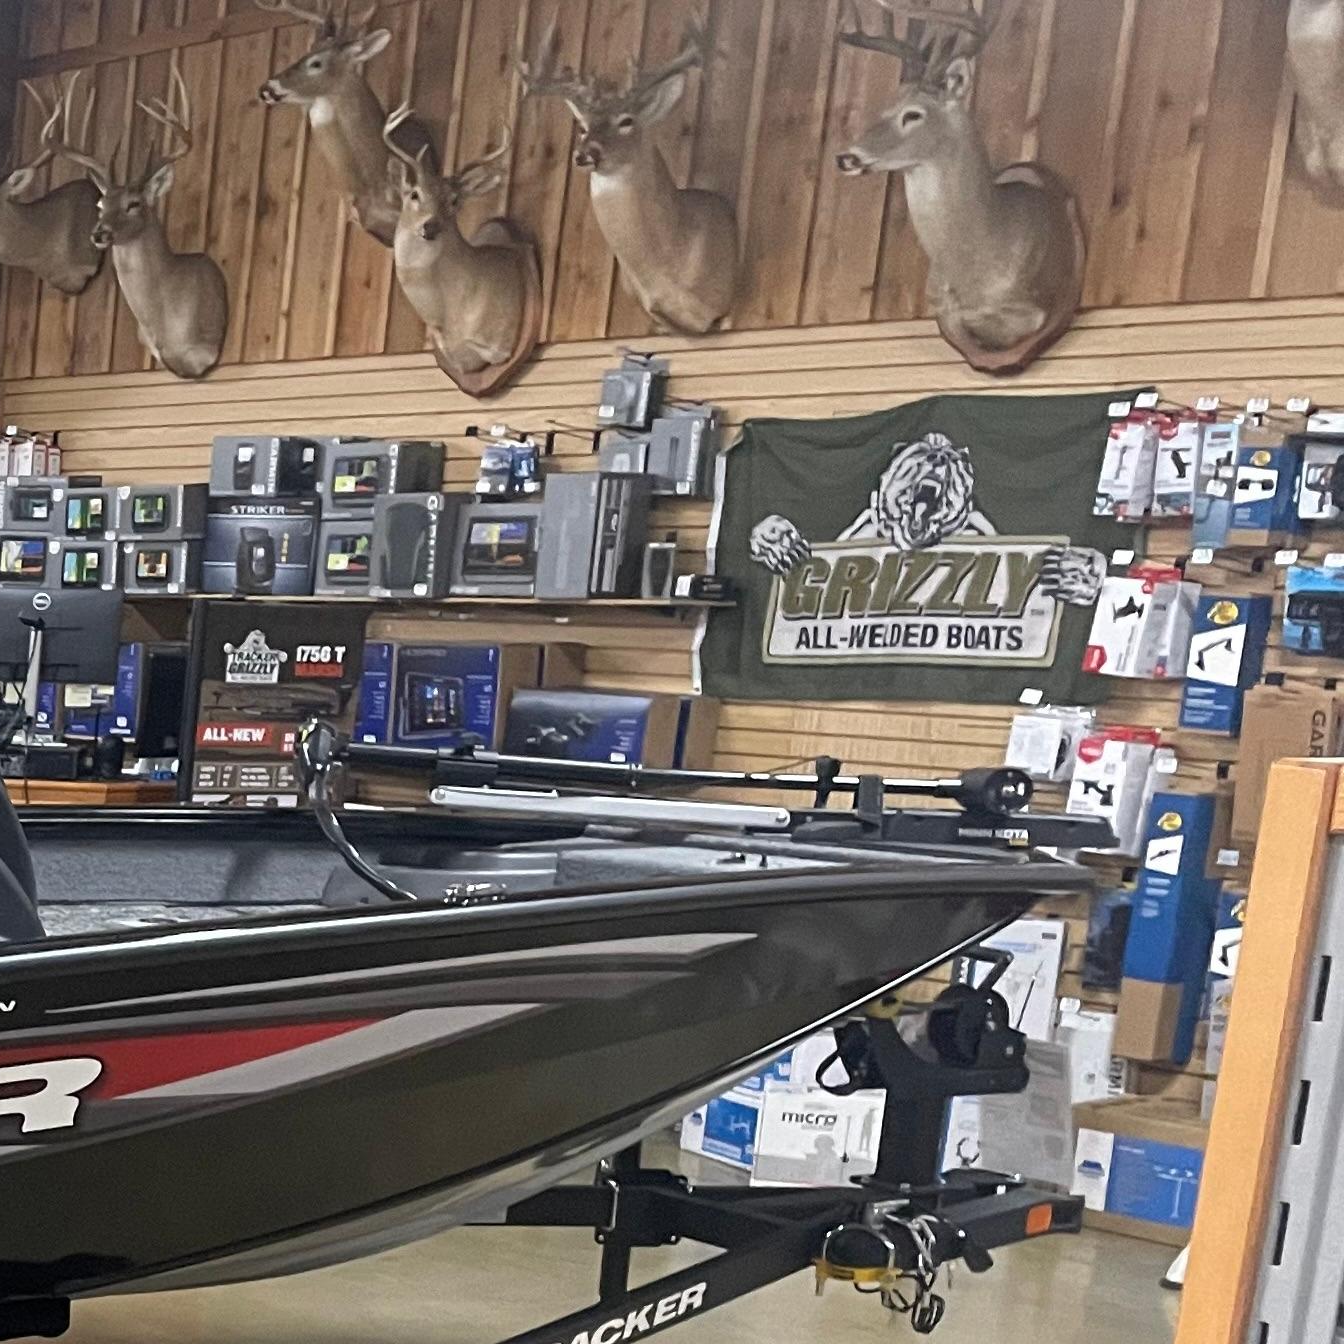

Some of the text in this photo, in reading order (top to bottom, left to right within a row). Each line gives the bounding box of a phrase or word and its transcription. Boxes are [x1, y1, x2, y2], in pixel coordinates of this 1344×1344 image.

[230, 504, 286, 515] STRIKER
[780, 550, 1047, 621] GRIZZLY
[795, 623, 1023, 651] ALL-WELDED BOATS
[334, 645, 347, 663] T
[228, 662, 278, 675] GRIZZLY
[202, 727, 266, 743] ALL-NEW
[781, 1112, 838, 1127] micro
